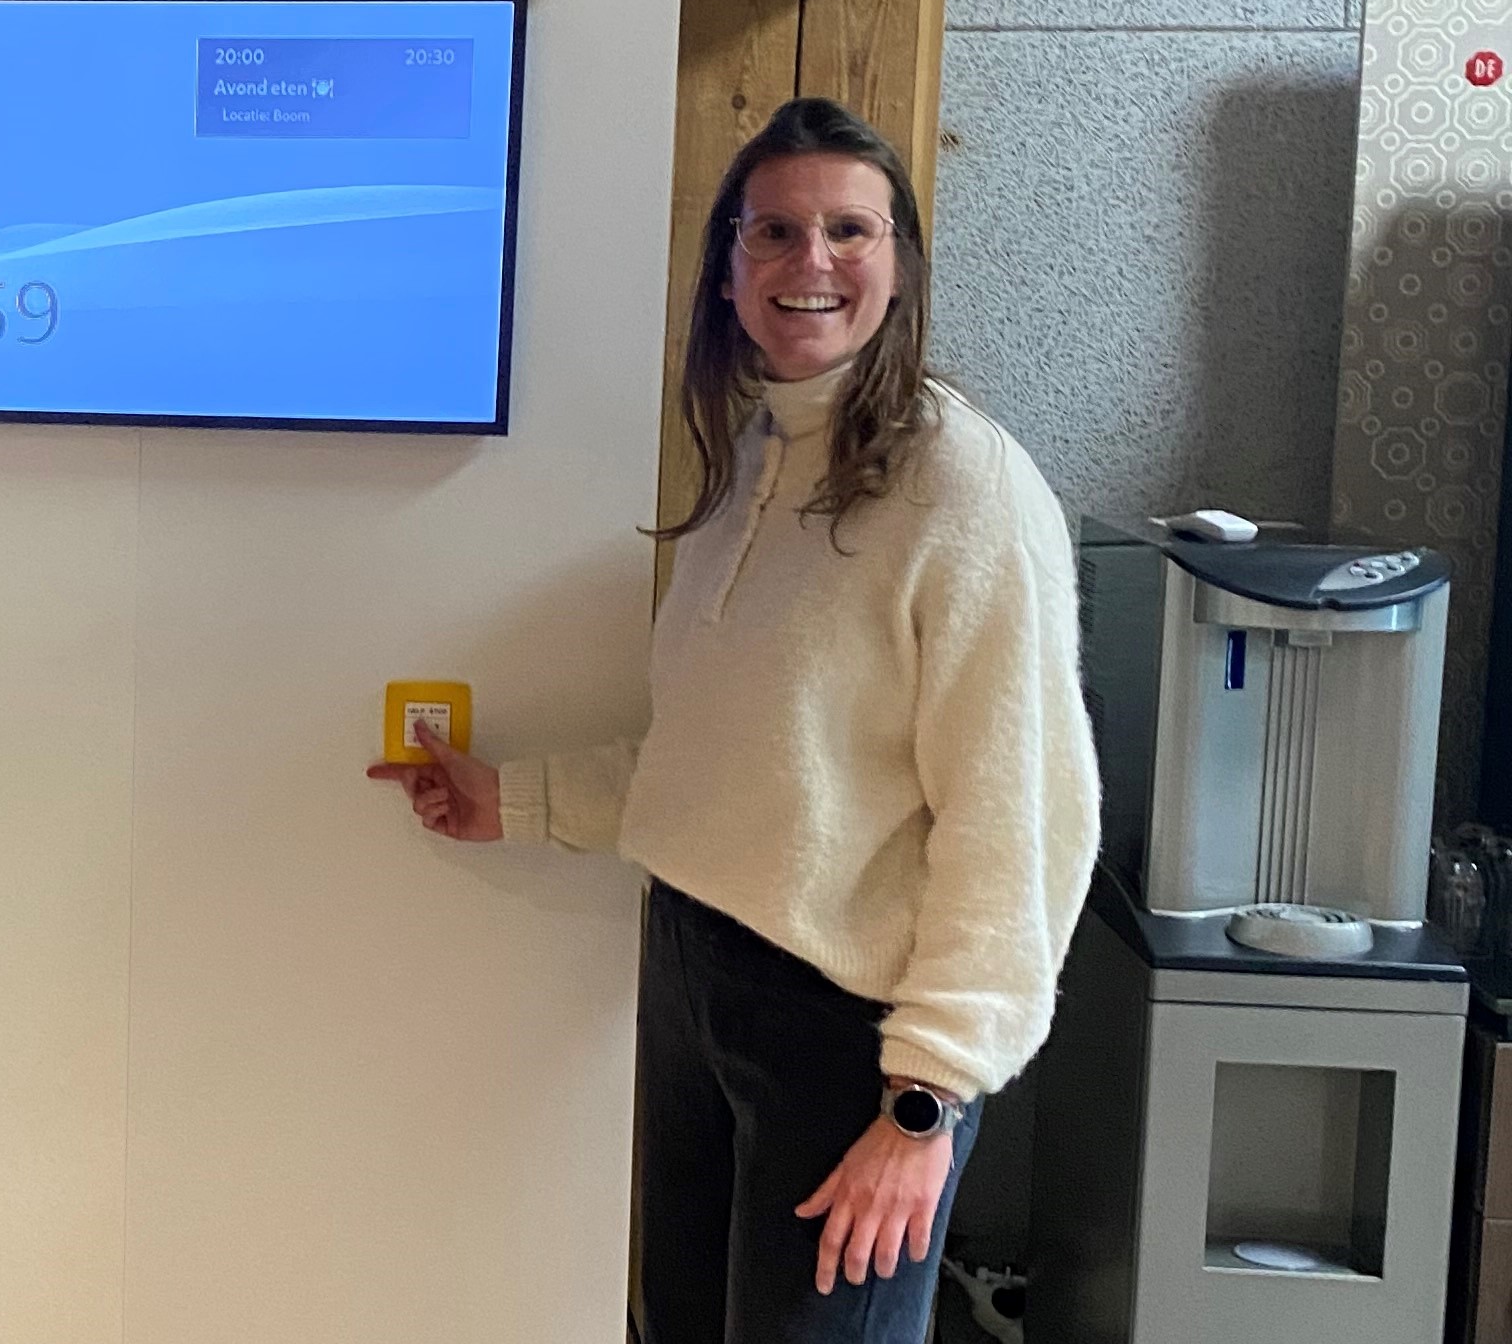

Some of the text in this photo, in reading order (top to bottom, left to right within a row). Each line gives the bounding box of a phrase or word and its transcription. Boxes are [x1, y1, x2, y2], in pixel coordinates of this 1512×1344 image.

[215, 48, 455, 65] 20:00 20:30
[273, 108, 311, 123] Boom
